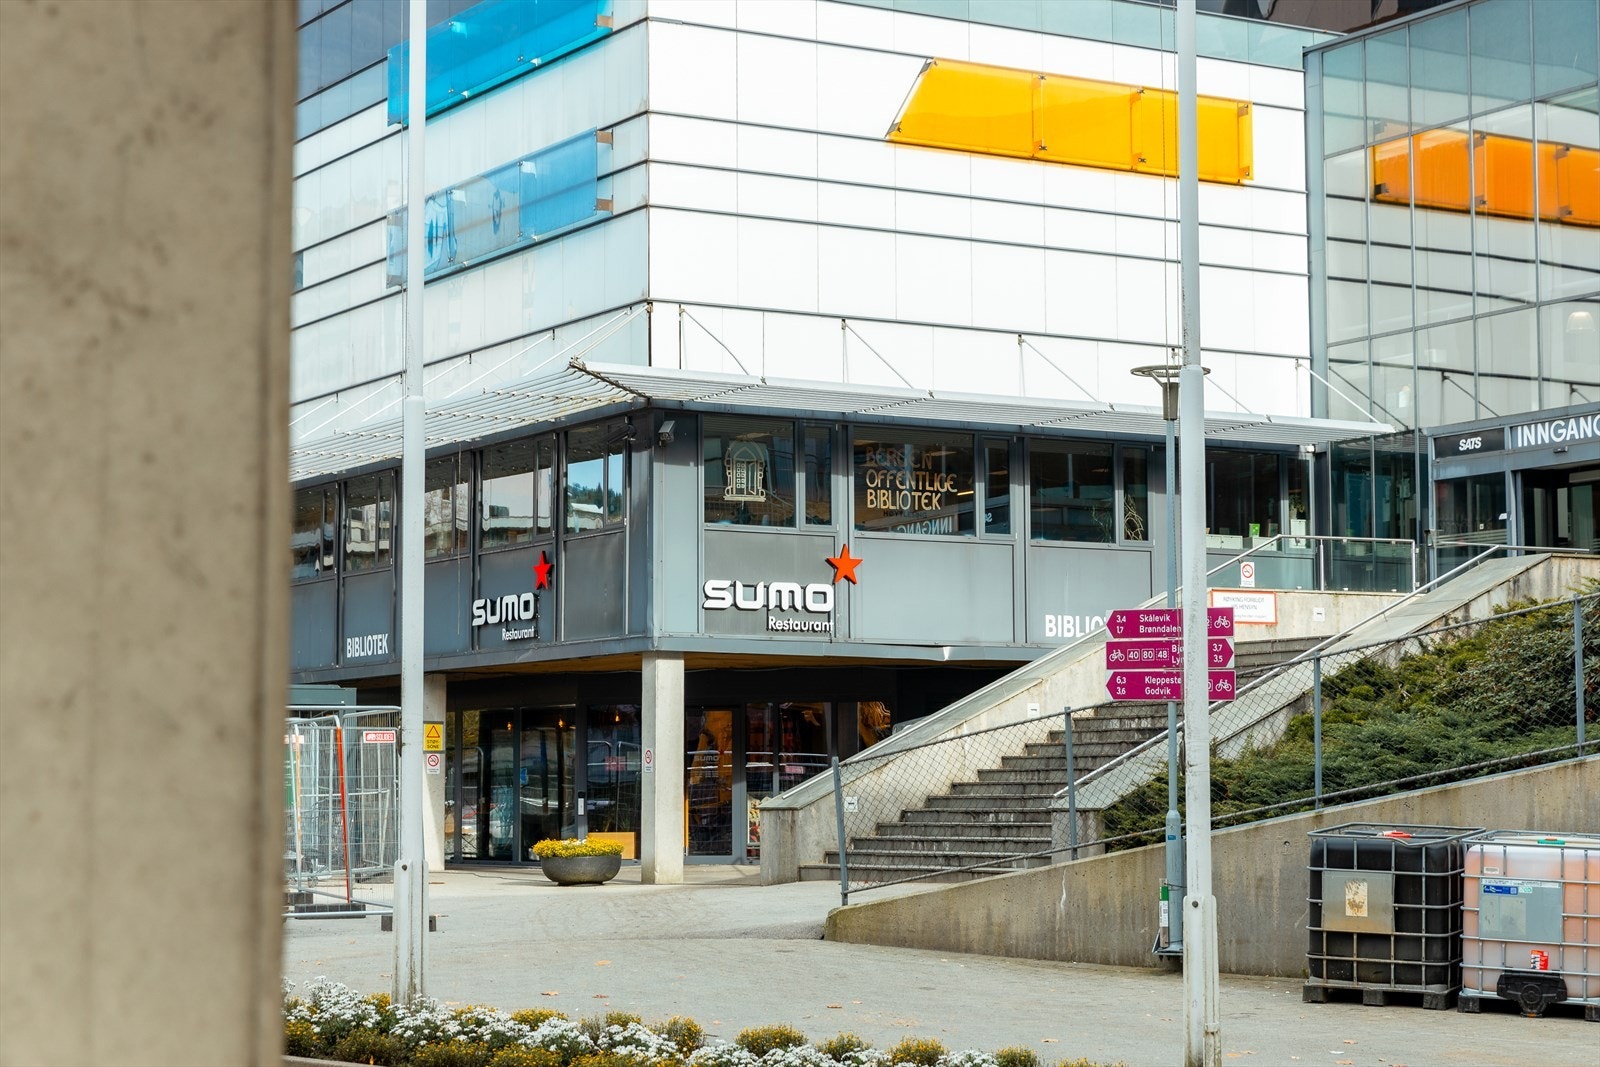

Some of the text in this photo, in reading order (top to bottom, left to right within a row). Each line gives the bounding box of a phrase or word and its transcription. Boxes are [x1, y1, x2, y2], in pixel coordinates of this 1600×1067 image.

[1459, 437, 1482, 451] SATS
[866, 469, 958, 493] OFFENTLIGE
[867, 489, 941, 511] BIBLIOTEK
[702, 580, 834, 612] SUMO
[472, 592, 535, 627] SUMO
[768, 616, 834, 632] Restaurant
[1045, 614, 1106, 638] BIBLIO
[1116, 614, 1171, 625] 3,4 Skålevik
[501, 626, 535, 641] Restaurant
[1116, 625, 1182, 635] 1,7 Brønndalen
[346, 634, 389, 659] BIBLIOTEK
[1212, 644, 1223, 652] 3,7
[1128, 650, 1168, 659] 40 80 48
[1213, 655, 1223, 664] 3,5
[1116, 676, 1127, 685] 6,3
[1116, 687, 1171, 696] 3,6 Godvik
